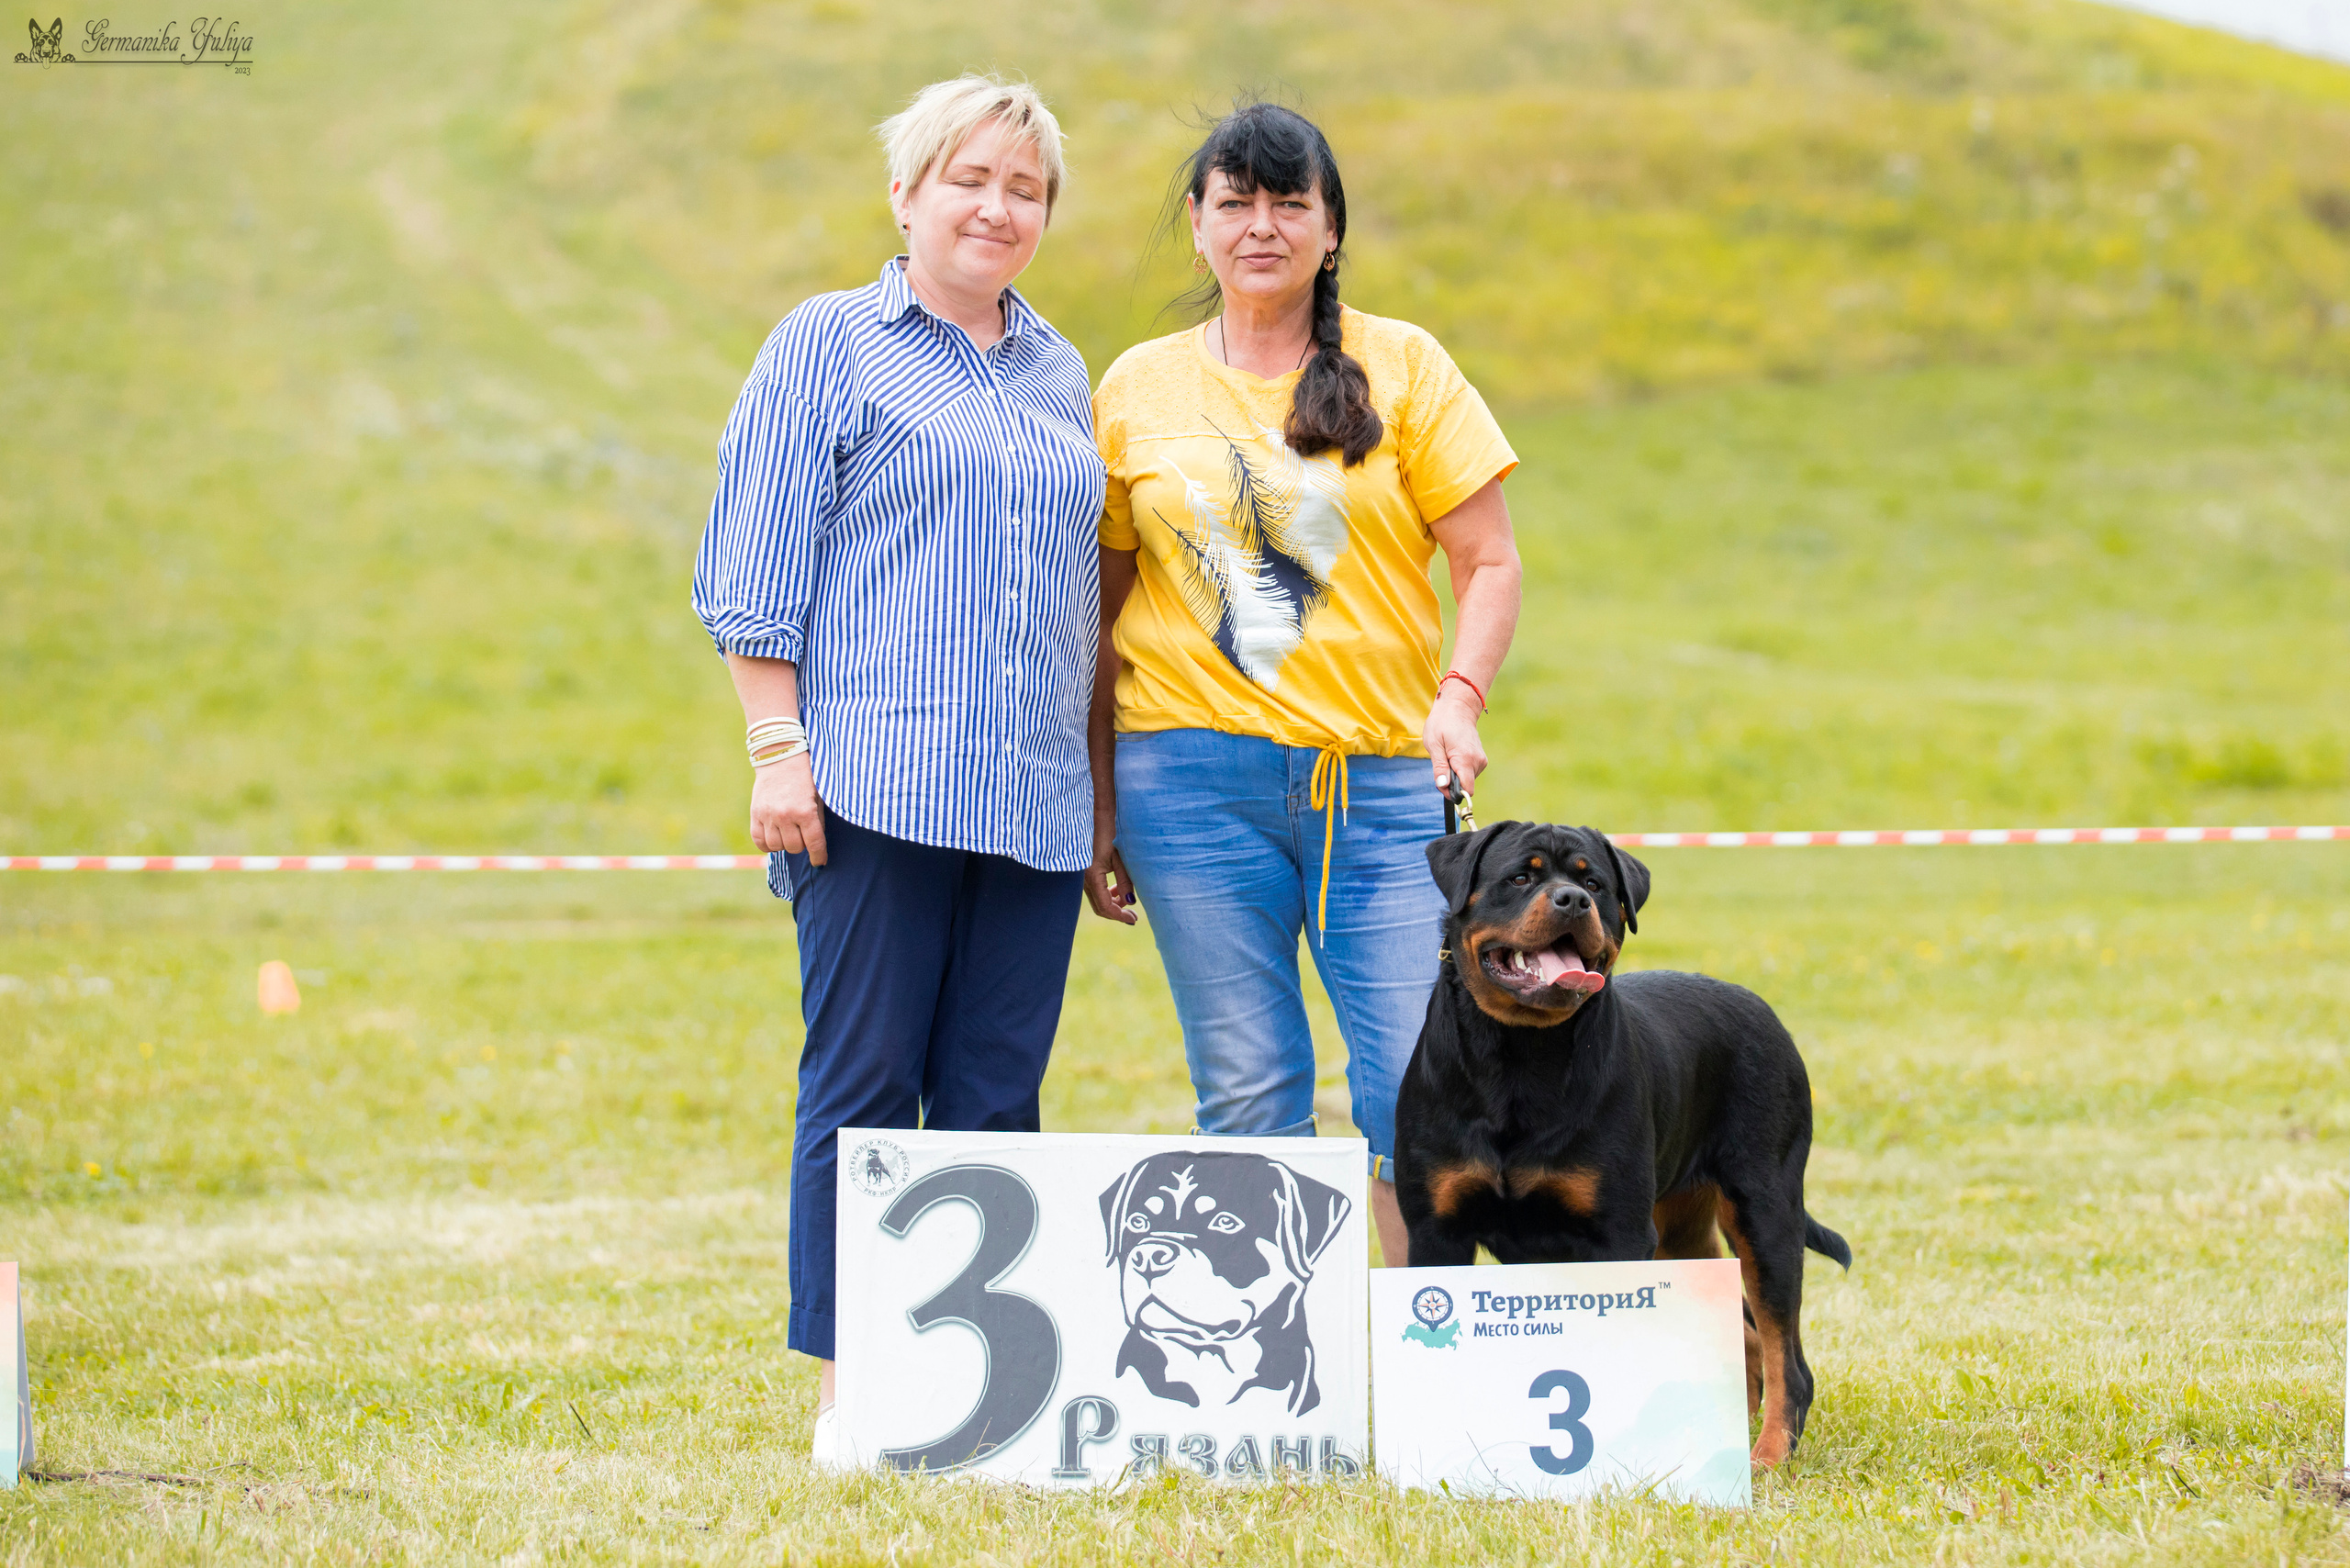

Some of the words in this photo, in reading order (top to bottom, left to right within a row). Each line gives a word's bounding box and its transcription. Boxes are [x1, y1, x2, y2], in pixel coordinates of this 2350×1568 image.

[878, 1140, 898, 1151] КЛУБ
[899, 1150, 910, 1182] РОССИИ
[878, 1163, 1062, 1475] 3
[1472, 1286, 1657, 1319] ТерриториЯ
[1528, 1369, 1595, 1475] 3
